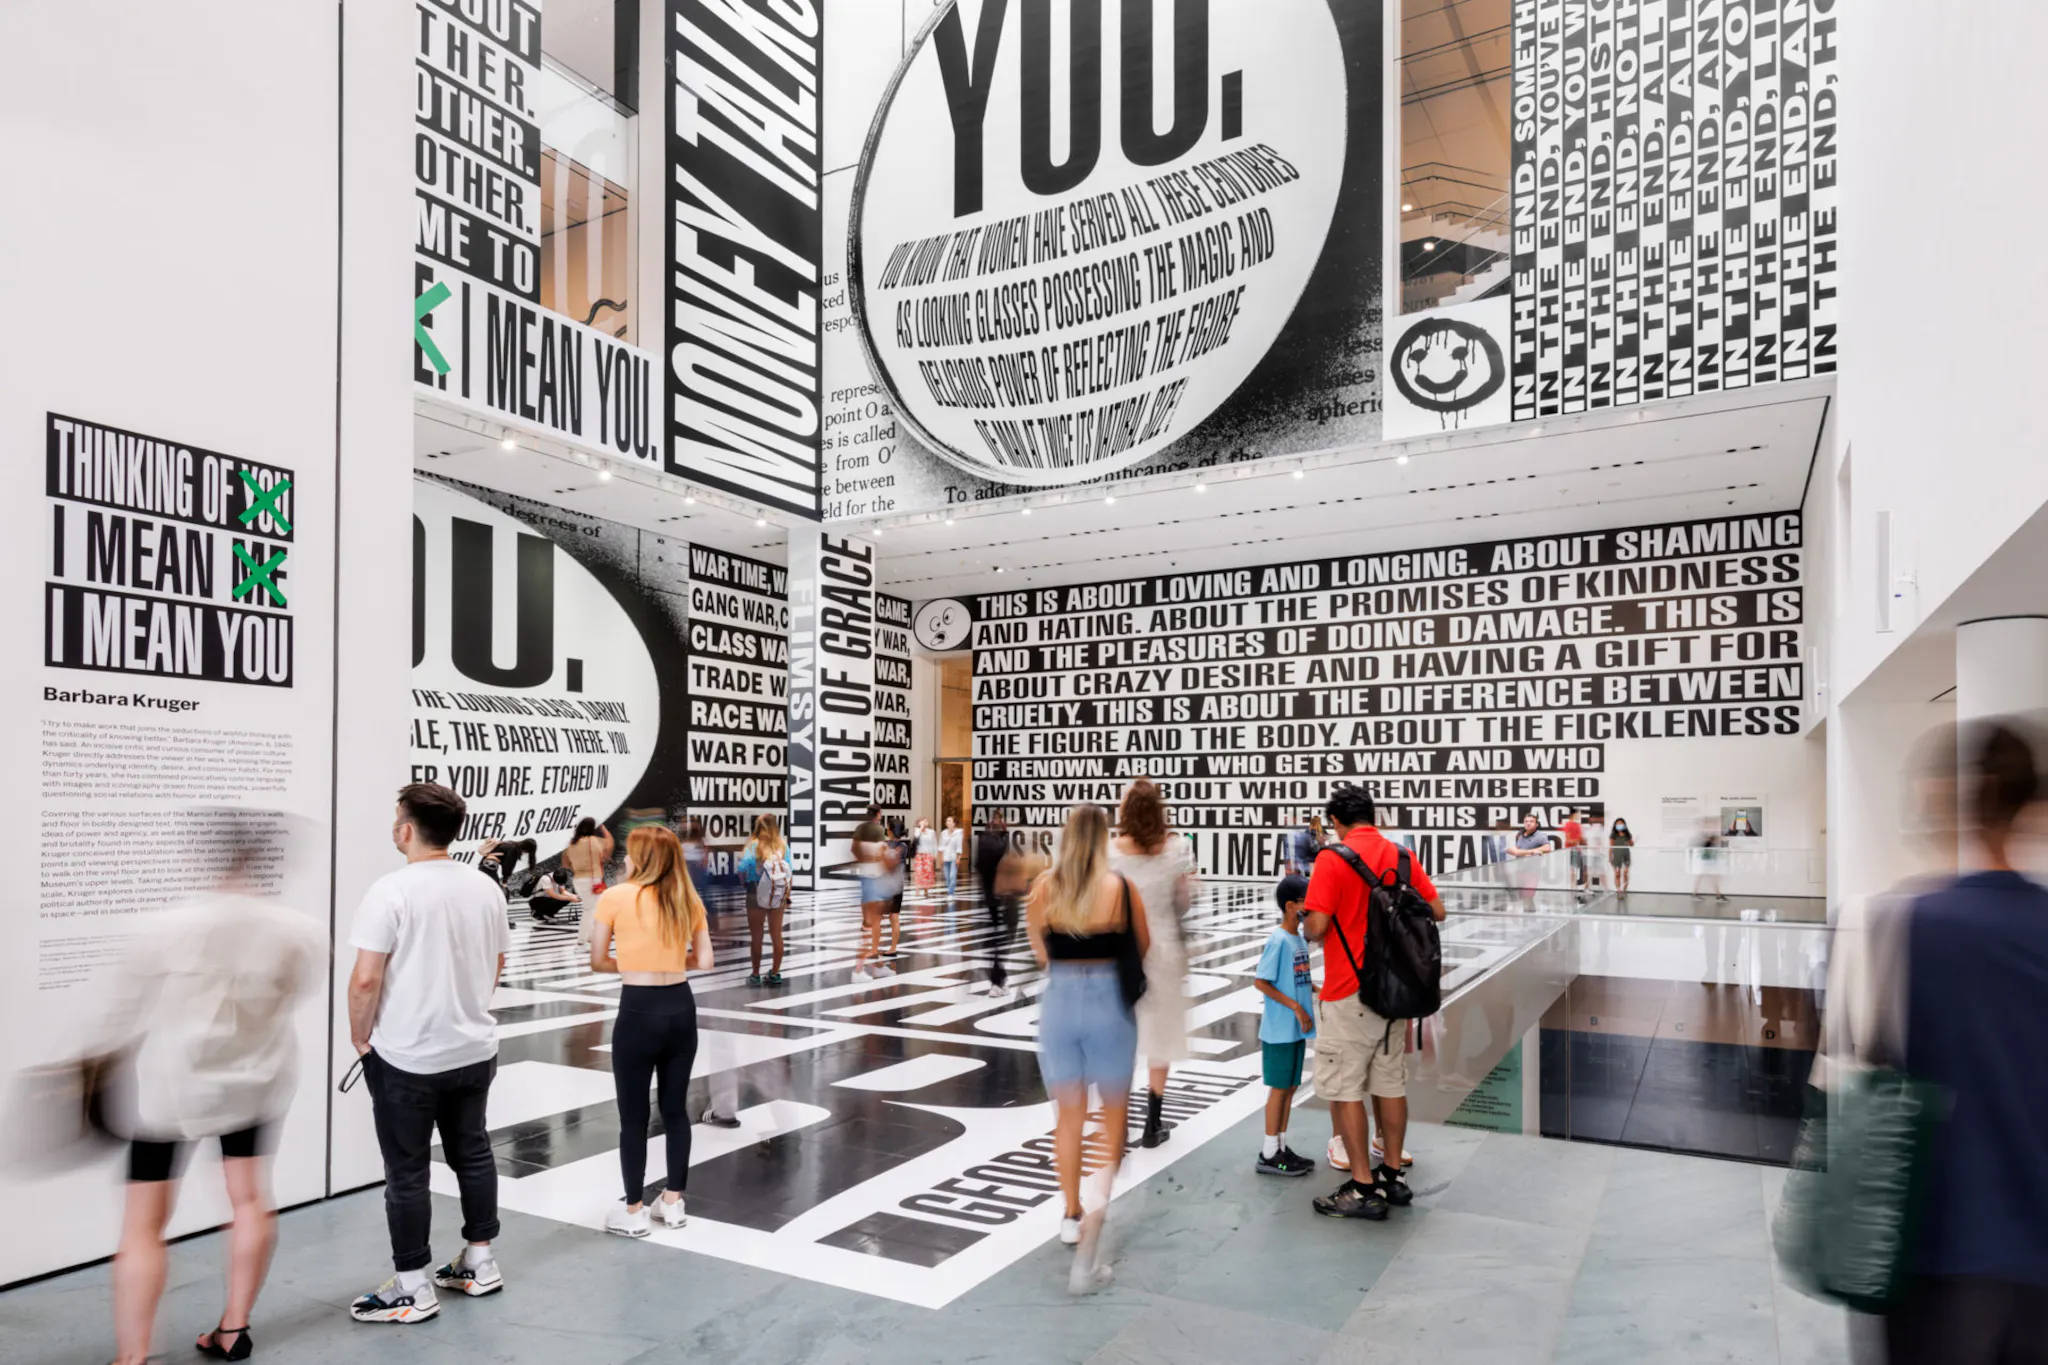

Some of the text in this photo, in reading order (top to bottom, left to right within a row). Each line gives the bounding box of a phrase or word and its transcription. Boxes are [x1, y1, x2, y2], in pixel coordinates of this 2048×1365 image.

[415, 64, 534, 177] OTHER.
[933, 0, 1242, 218] YOU.
[415, 133, 533, 235] OTHER.
[943, 227, 983, 282] THAT
[977, 215, 1030, 276] WOMEN
[1033, 206, 1067, 264] HAVE
[1070, 192, 1126, 254] SERVED
[1121, 184, 1160, 237] ALL
[1146, 170, 1213, 226] THESE
[1192, 143, 1300, 209] CENTURIES
[1565, 47, 1586, 414] IN THE END, YOU
[1815, 74, 1837, 374] IN THE END,
[415, 197, 534, 293] ME TO
[672, 0, 818, 510] MONEY TALK
[1670, 110, 1692, 397] IN THE END,
[897, 207, 1274, 348] AS LOOKING GLASSES POSSESSING THE MAGIC AND
[1515, 151, 1536, 420] IN THE END,
[918, 284, 1246, 409] DELICIOUS POWER OF REFLECTING THE FIGURE
[462, 282, 657, 461] I MEAN YOU.
[825, 406, 862, 431] point
[838, 421, 896, 448] is called
[1038, 414, 1074, 469] TWICE
[1076, 408, 1094, 465] ITS
[54, 419, 289, 536] THINKING OF YOU
[836, 453, 869, 471] from
[836, 473, 895, 493] between
[846, 494, 895, 515] for the
[945, 486, 967, 504] To
[502, 504, 602, 538] degrees of
[54, 505, 287, 610] I MEAN ME
[692, 549, 771, 595] WAR TIME,
[977, 514, 1799, 620] THIS IS ABOUT LOVING AND LONGING. ABOUT SHAMING
[692, 588, 778, 631] GANG WAR,
[820, 532, 872, 660] GRACE
[877, 597, 911, 629] GAME,
[977, 553, 1799, 645] AND HATING. ABOUT PROMISES KINDNESS
[52, 588, 288, 682] I MEAN YOU
[692, 625, 756, 659] CLASS
[882, 631, 910, 657] WAR,
[1098, 604, 1625, 667] PLEASURES DOING DAMAGE.
[692, 664, 762, 695] TRADE
[877, 661, 910, 687] WAR,
[1073, 629, 1799, 696] CRAZY DESIRE HAVING A GIFT FOR
[43, 687, 200, 713] Barbara Kruger
[447, 692, 533, 716] LOOKING
[820, 667, 872, 716] OF
[977, 667, 1800, 730] CRUELTY. DIFFERENCE BETWEEN
[449, 721, 630, 754] THE BARELY THERE. YOU.
[692, 701, 752, 731] RACE
[1029, 705, 1799, 754] FIGURE BODY. FICKLENESS
[448, 765, 608, 797] YOU ARE. ETCHED IN
[874, 752, 909, 773] WAR
[1006, 751, 1436, 778] RENOWN. WHO GETS WHAT
[690, 776, 781, 802] WITHOUT
[975, 778, 1599, 800] OWNS REMEMBERED
[513, 805, 581, 837] IS GONE.
[1406, 806, 1476, 827] THIS
